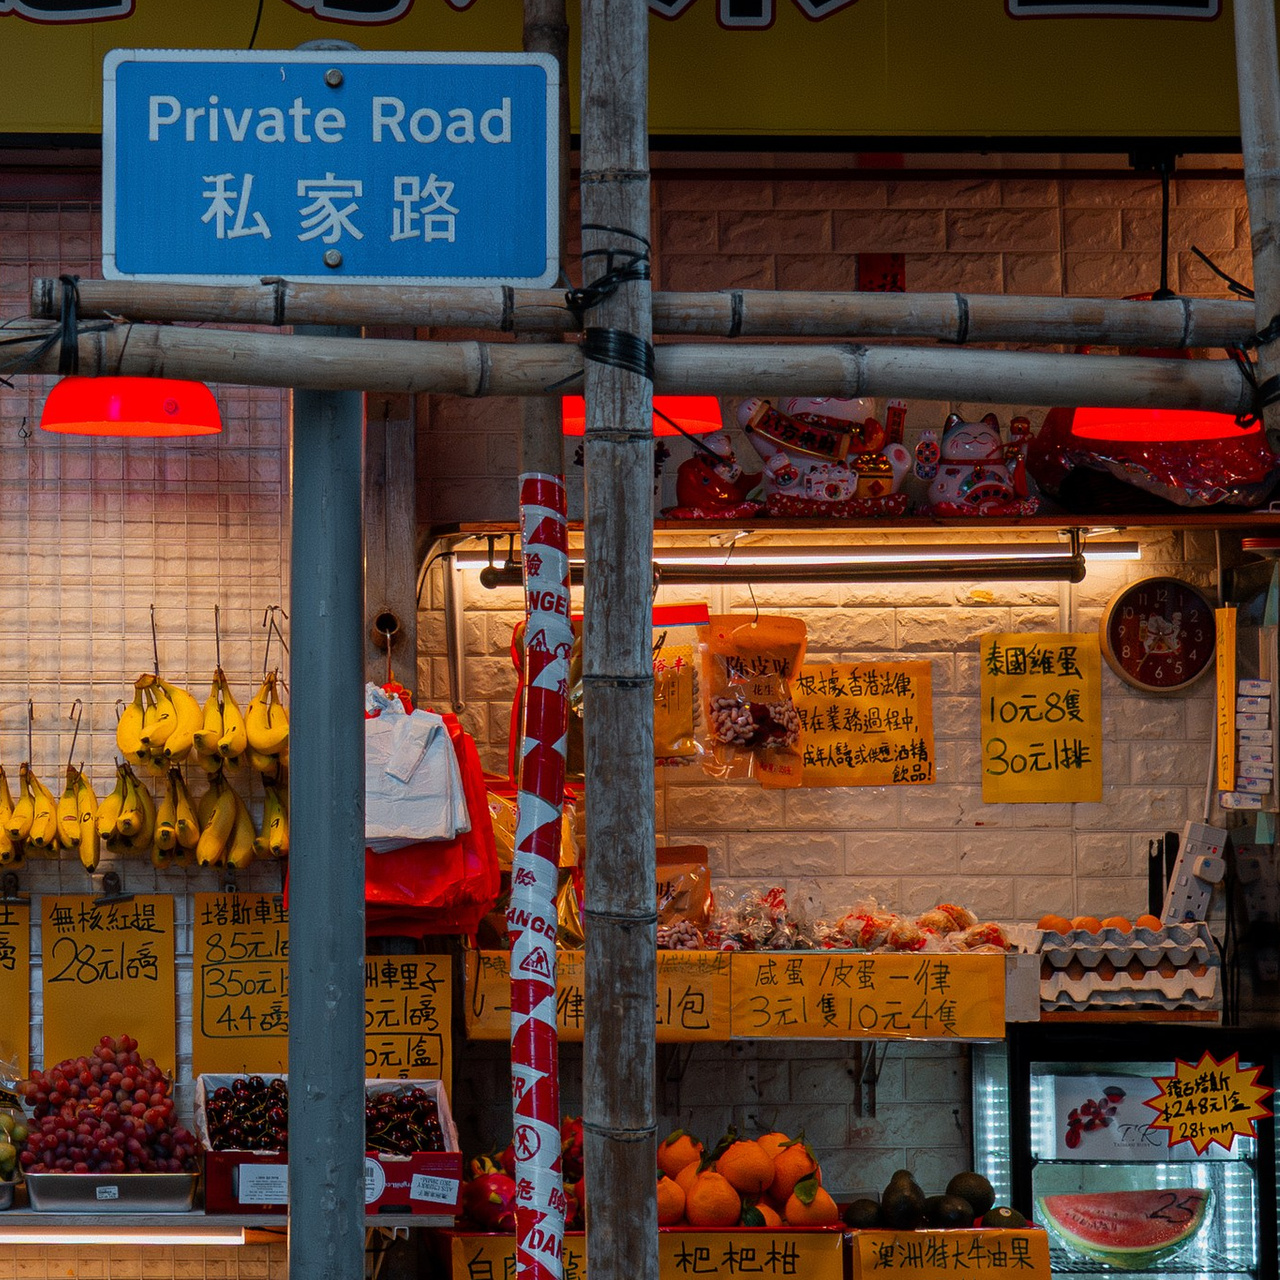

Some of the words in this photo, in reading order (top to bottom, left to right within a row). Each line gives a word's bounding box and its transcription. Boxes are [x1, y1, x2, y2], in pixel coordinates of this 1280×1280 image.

[148, 94, 347, 144] Private
[372, 95, 512, 144] Road
[200, 171, 460, 245] 私家路
[48, 900, 166, 935] 無核紅提
[205, 967, 289, 999] 350元1
